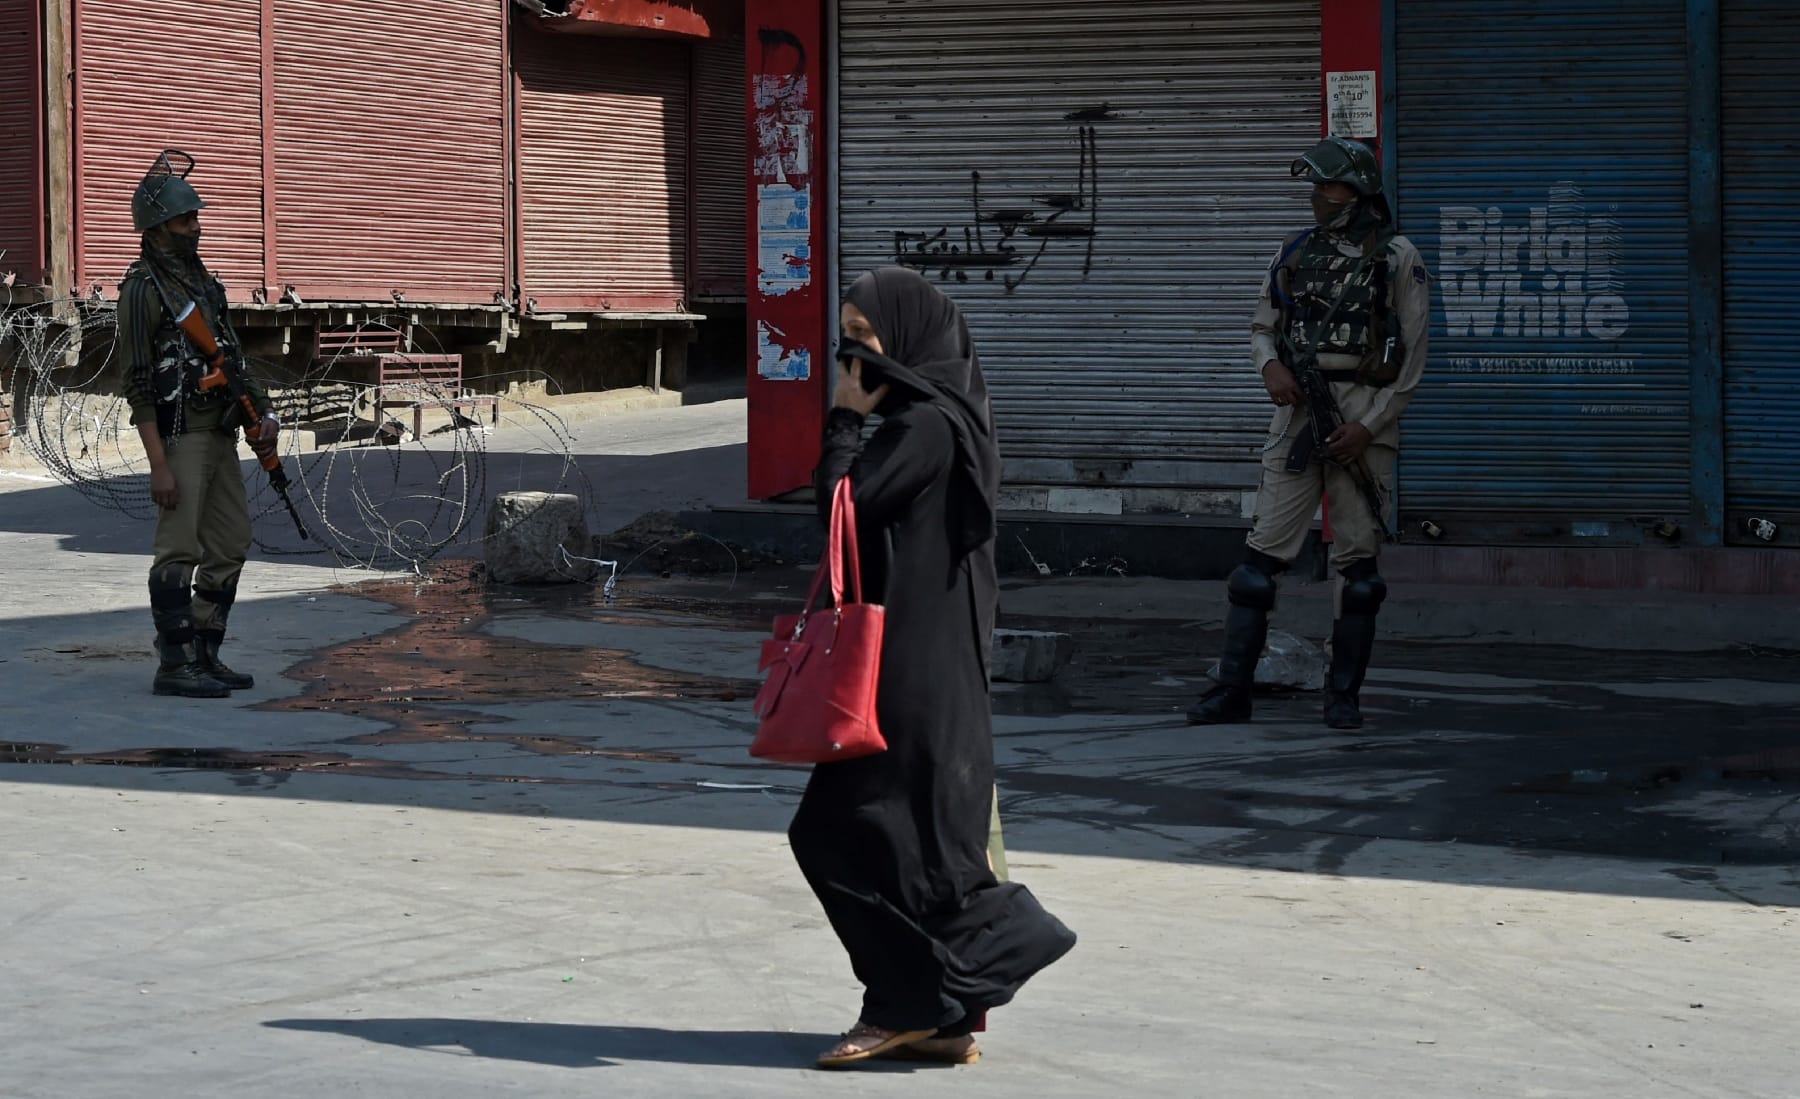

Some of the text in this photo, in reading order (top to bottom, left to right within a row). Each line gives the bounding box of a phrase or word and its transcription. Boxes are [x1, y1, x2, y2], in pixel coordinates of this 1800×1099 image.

[1439, 207, 1586, 272] Birla
[1440, 274, 1630, 340] White
[1448, 358, 1473, 373] THE
[1546, 358, 1584, 373] WHITE
